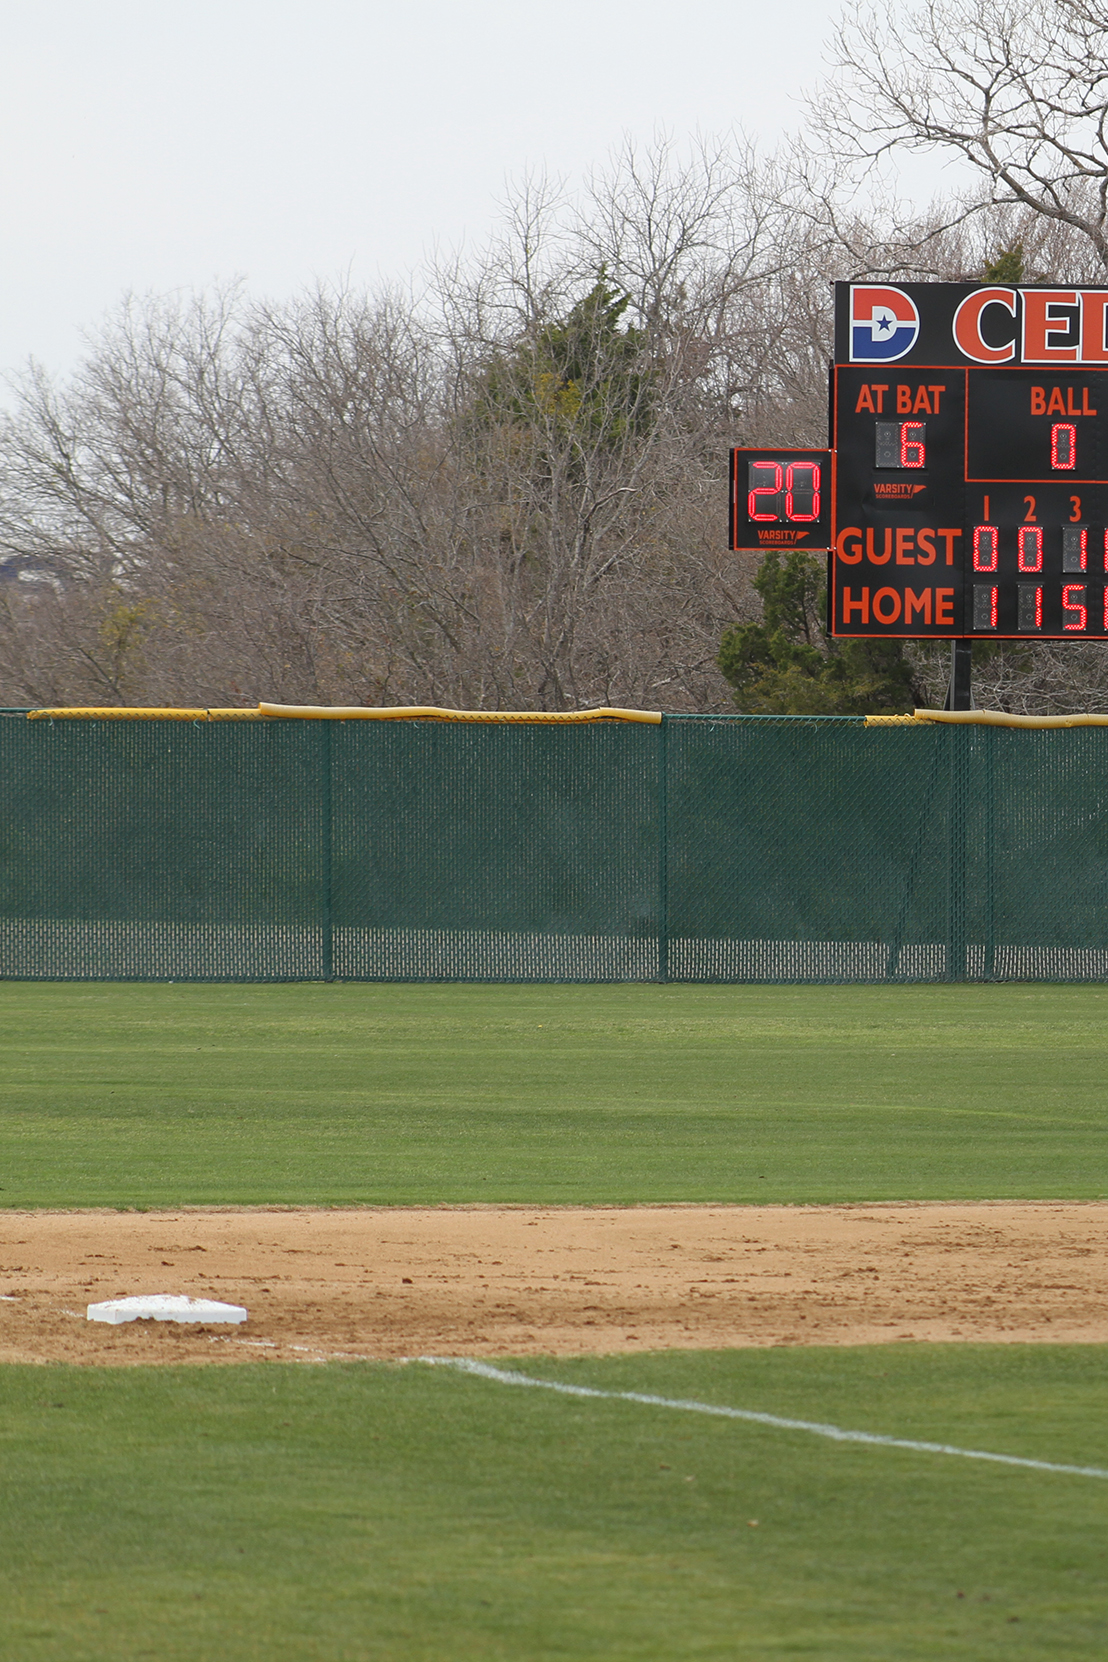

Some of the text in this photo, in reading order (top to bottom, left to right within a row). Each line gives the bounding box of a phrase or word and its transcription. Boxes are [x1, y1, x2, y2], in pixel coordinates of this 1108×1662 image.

[855, 384, 946, 414] AT BAT
[1031, 387, 1097, 416] BALL
[900, 421, 926, 468] 6
[1050, 423, 1077, 470] 0
[747, 461, 821, 522] 20
[874, 484, 912, 493] VARSITY
[984, 495, 989, 521] 1
[1024, 496, 1037, 522] 2
[1070, 496, 1081, 522] 3
[757, 530, 796, 539] VARSITY
[836, 527, 962, 565] GUEST
[972, 525, 999, 572] 0
[1017, 526, 1044, 572] 0
[1080, 530, 1088, 570] 1
[843, 587, 954, 625] HOME
[990, 587, 998, 627] 1
[1035, 587, 1043, 627] 1
[1061, 584, 1088, 630] 5
